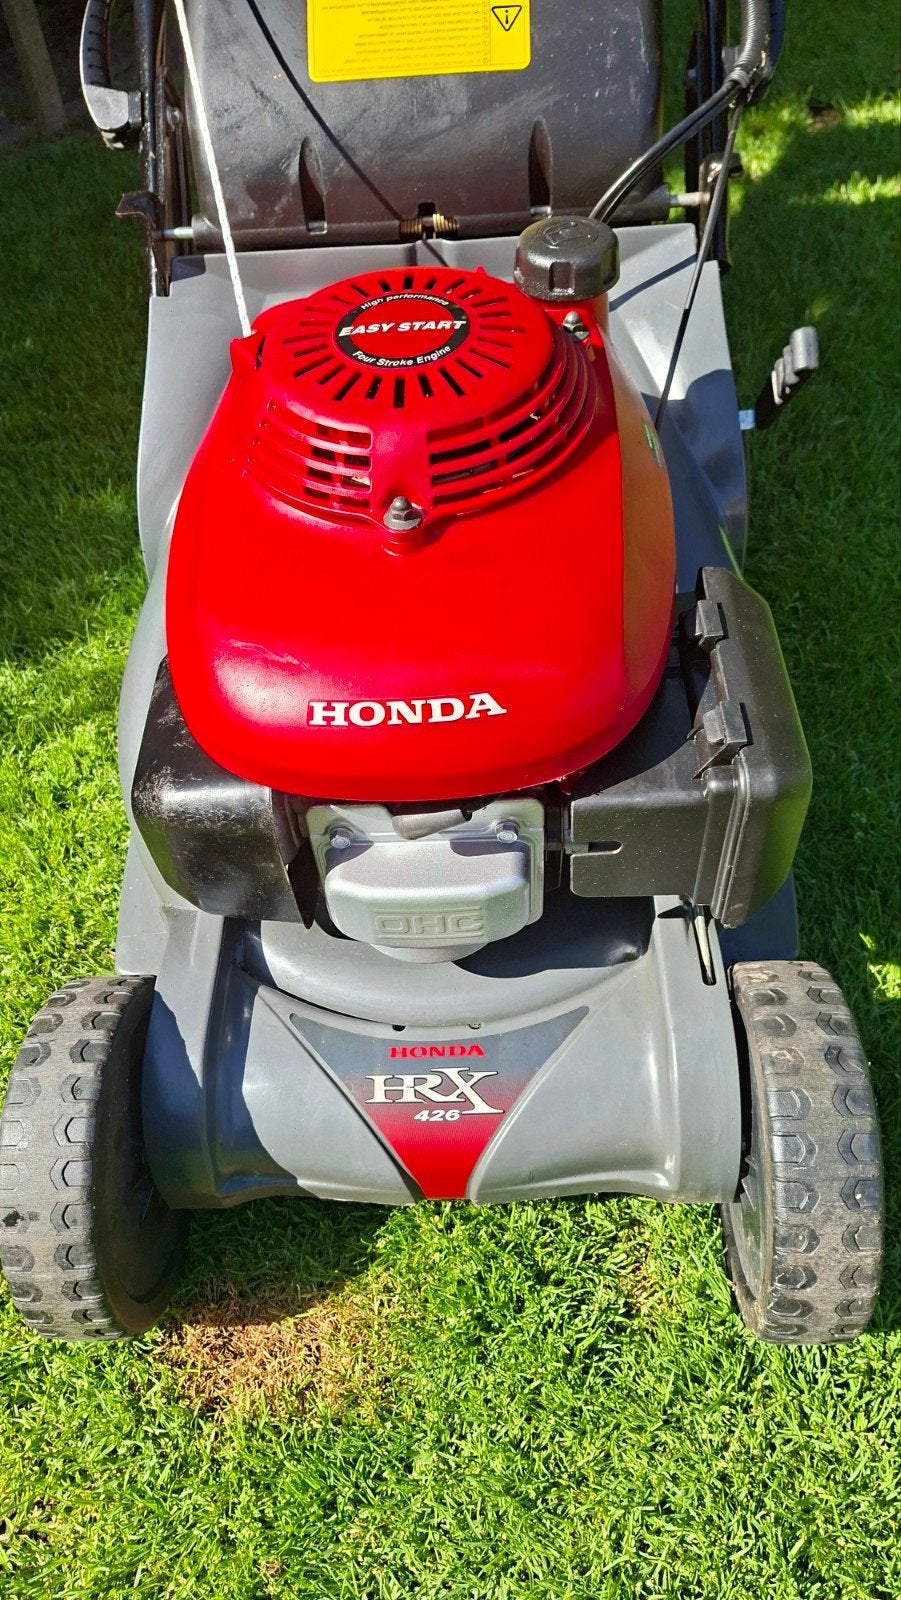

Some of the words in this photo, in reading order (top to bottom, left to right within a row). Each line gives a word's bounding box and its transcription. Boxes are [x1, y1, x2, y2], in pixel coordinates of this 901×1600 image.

[360, 297, 384, 310] High
[386, 293, 450, 306] performance
[338, 322, 395, 337] EASY
[397, 320, 467, 332] START
[352, 350, 376, 363] Four
[376, 358, 413, 367] Stroke
[417, 346, 451, 364] Engine
[308, 692, 507, 727] HONDA
[375, 913, 484, 934] OHC
[390, 1044, 486, 1058] HONDA
[365, 1067, 505, 1115] HRX
[414, 1109, 461, 1122] 426
